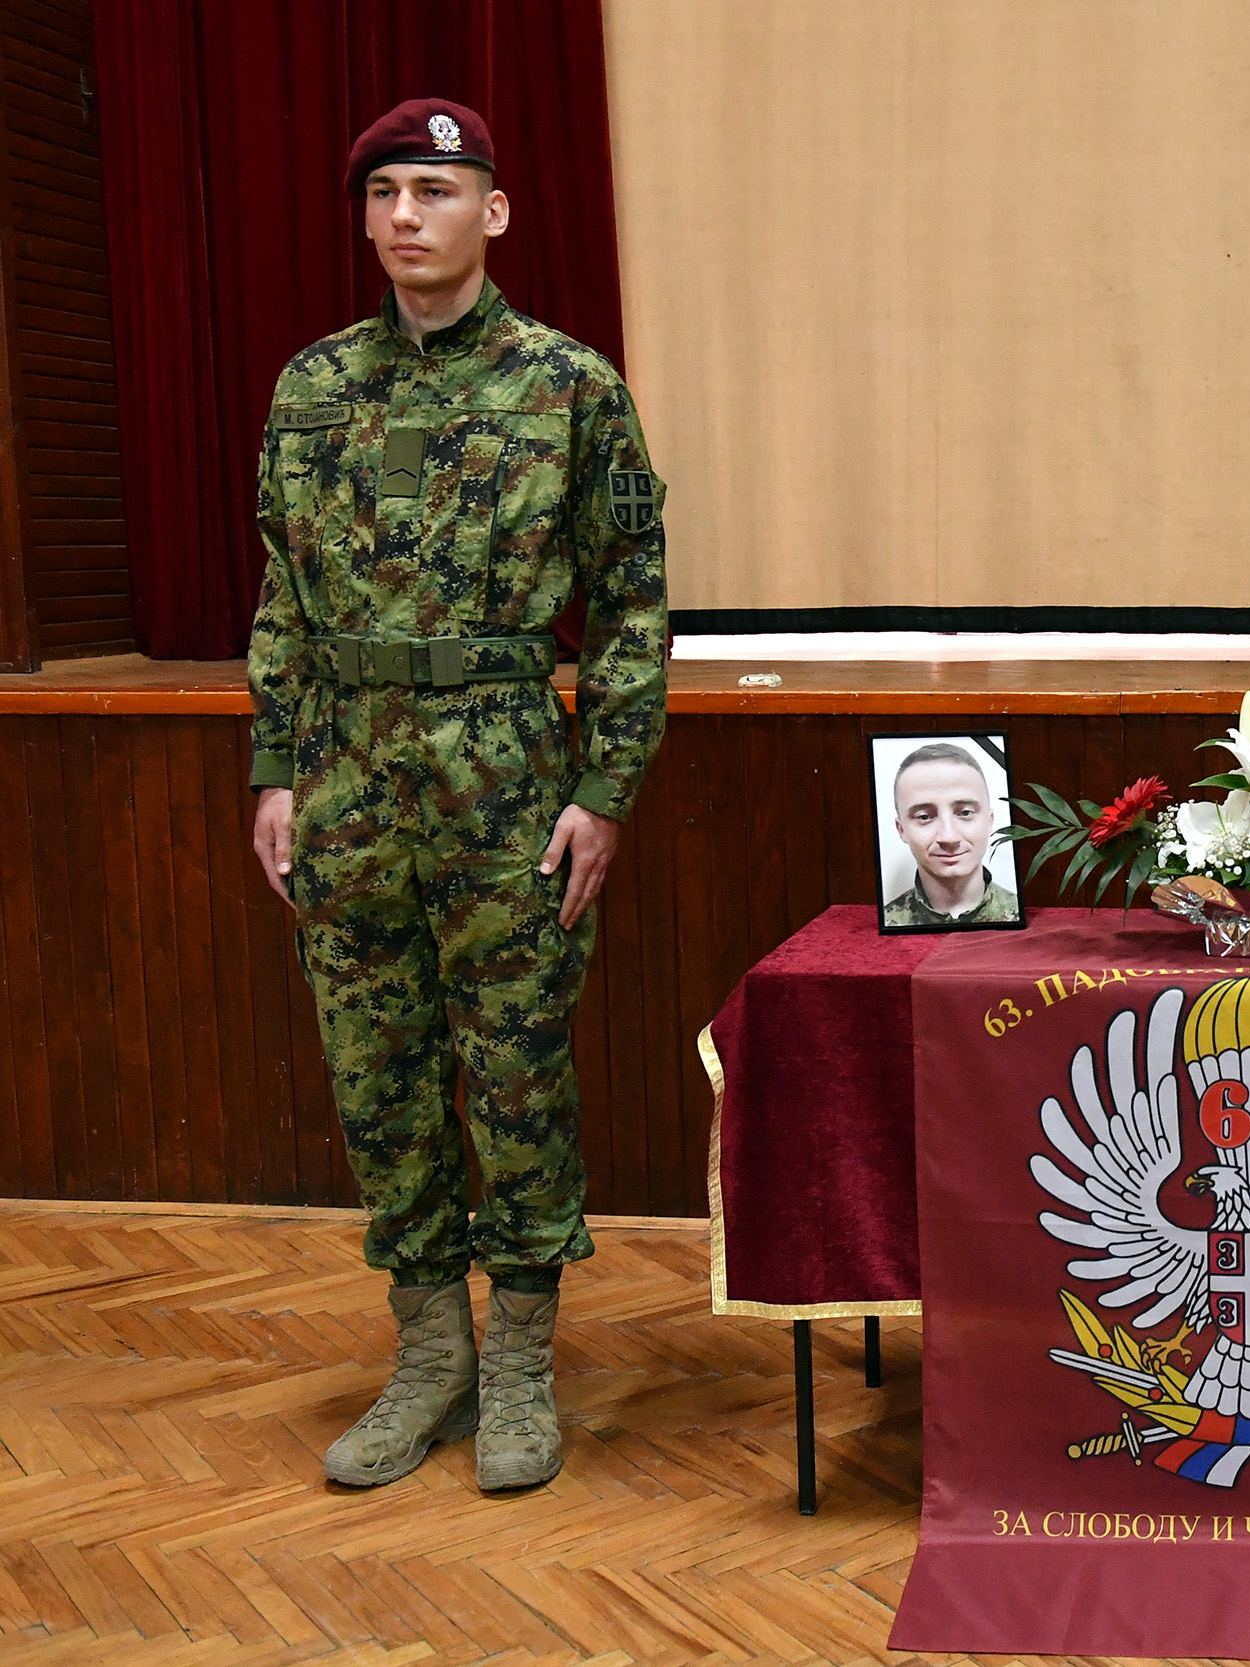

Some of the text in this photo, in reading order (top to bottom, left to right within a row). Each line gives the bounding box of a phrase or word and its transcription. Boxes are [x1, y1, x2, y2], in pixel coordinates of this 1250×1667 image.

[284, 413, 295, 425] М.
[984, 998, 1033, 1037] 63.
[992, 1509, 1033, 1536] ЗА
[1042, 1511, 1201, 1544] СЛОБОДУ
[1211, 1515, 1235, 1541] И
